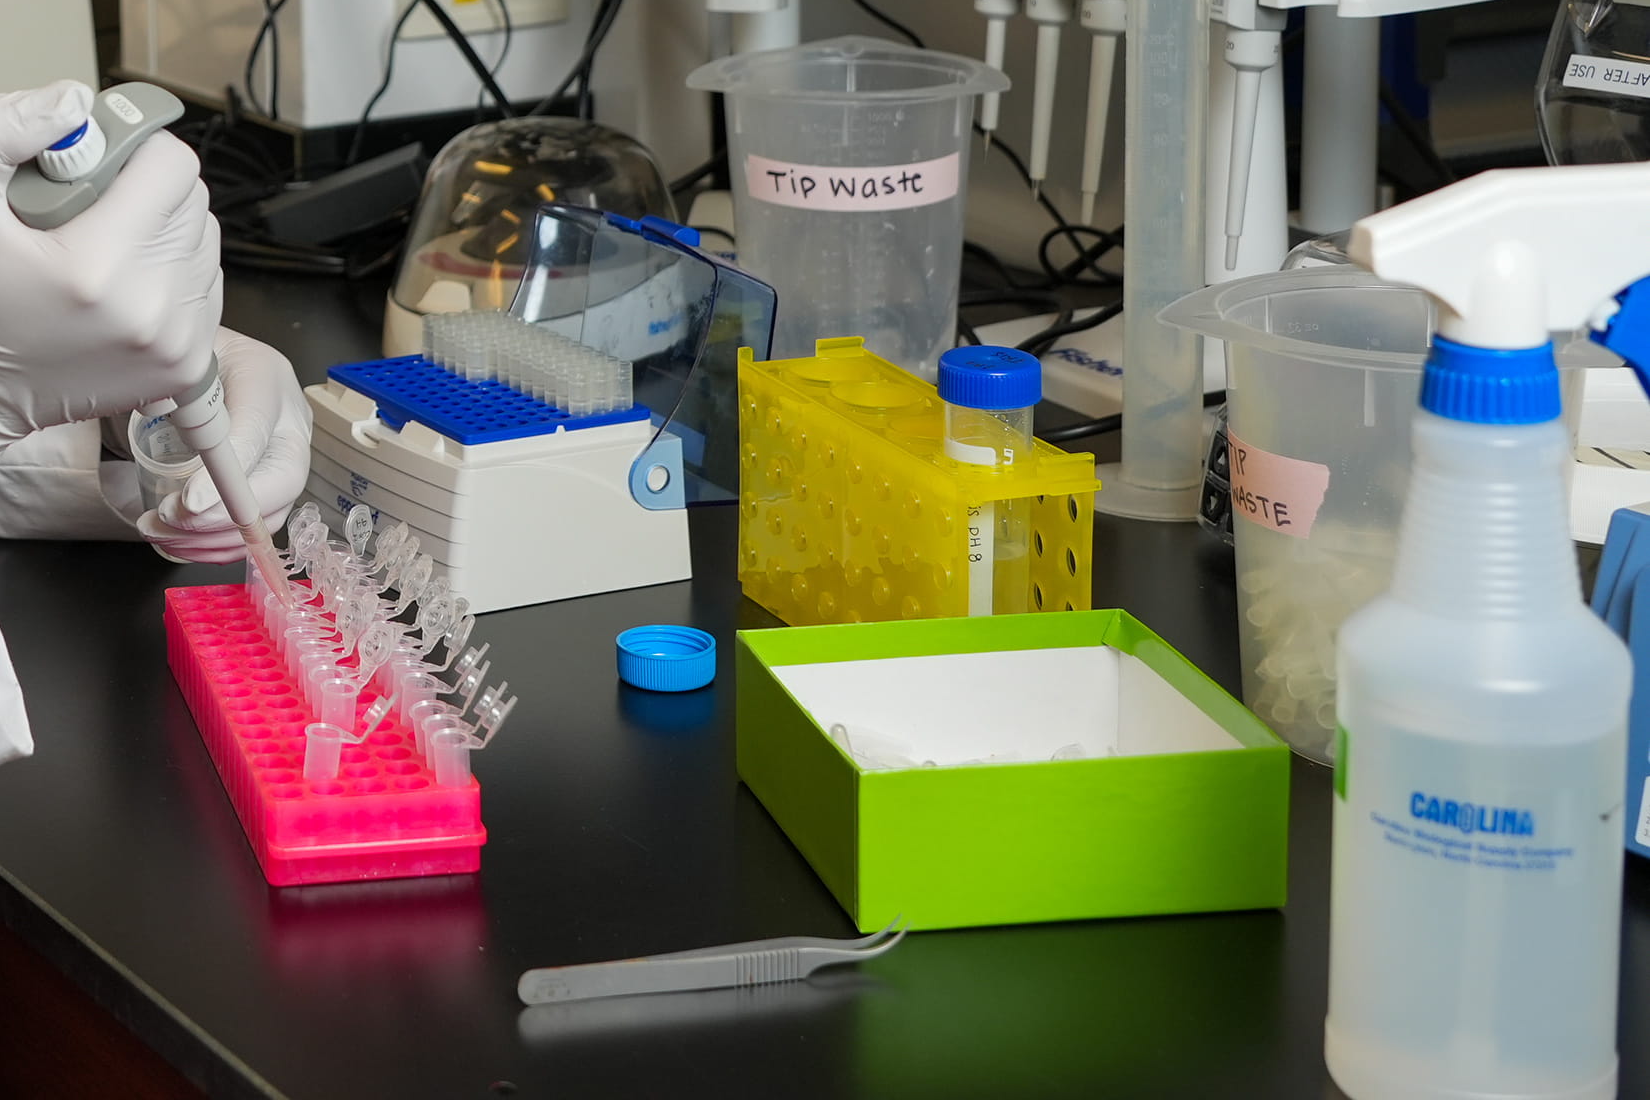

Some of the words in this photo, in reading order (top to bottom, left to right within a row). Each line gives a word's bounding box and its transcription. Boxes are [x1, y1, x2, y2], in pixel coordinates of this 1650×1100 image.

[1568, 62, 1596, 80] USE
[1228, 441, 1247, 476] TIP
[1232, 488, 1291, 528] WASTE
[1410, 791, 1535, 837] CAROLINA
